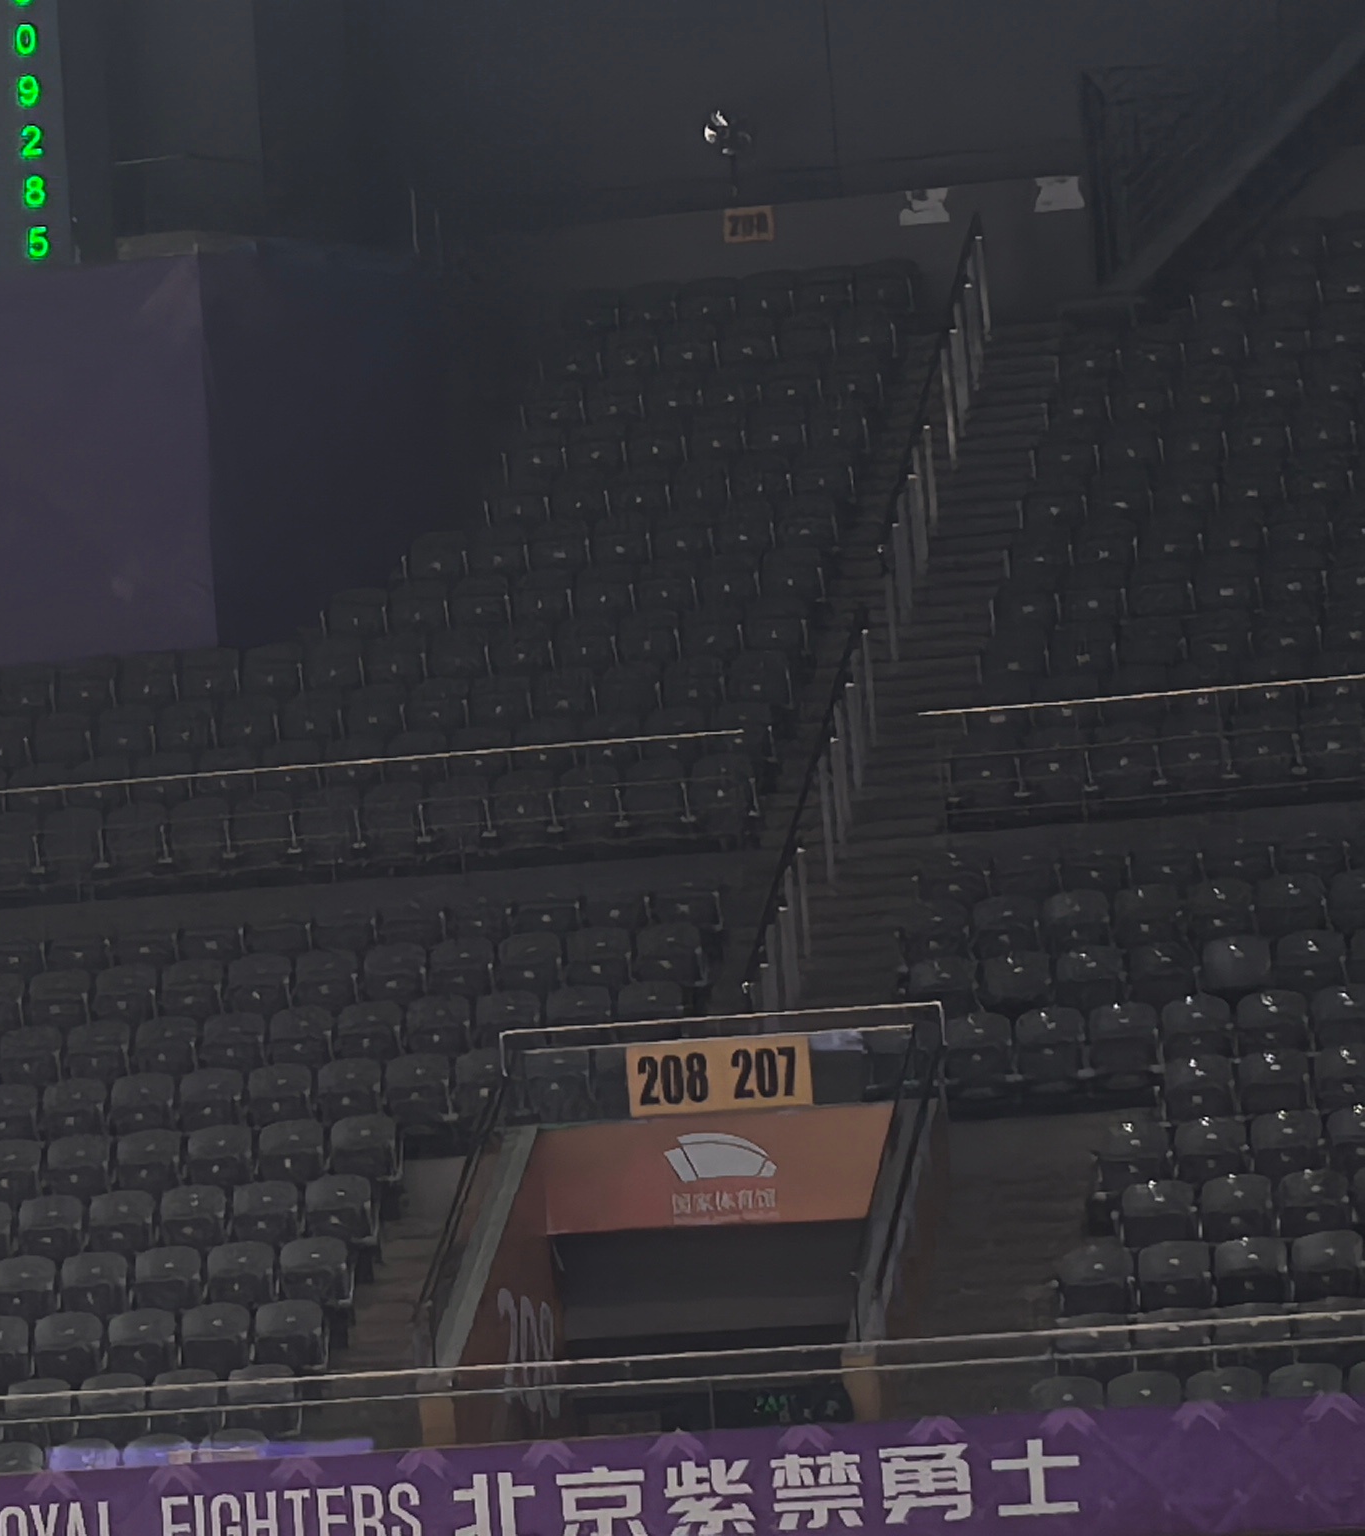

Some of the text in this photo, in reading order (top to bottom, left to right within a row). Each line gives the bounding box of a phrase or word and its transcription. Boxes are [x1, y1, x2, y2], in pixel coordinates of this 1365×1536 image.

[14, 24, 38, 57] 0
[17, 74, 42, 109] 9
[21, 125, 44, 159] 2
[23, 175, 47, 210] 8
[27, 227, 51, 261] 5
[637, 1046, 796, 1106] 208 207
[451, 1437, 1081, 1536] 北京紫禁勇士
[160, 1482, 422, 1536] FIGHTERS
